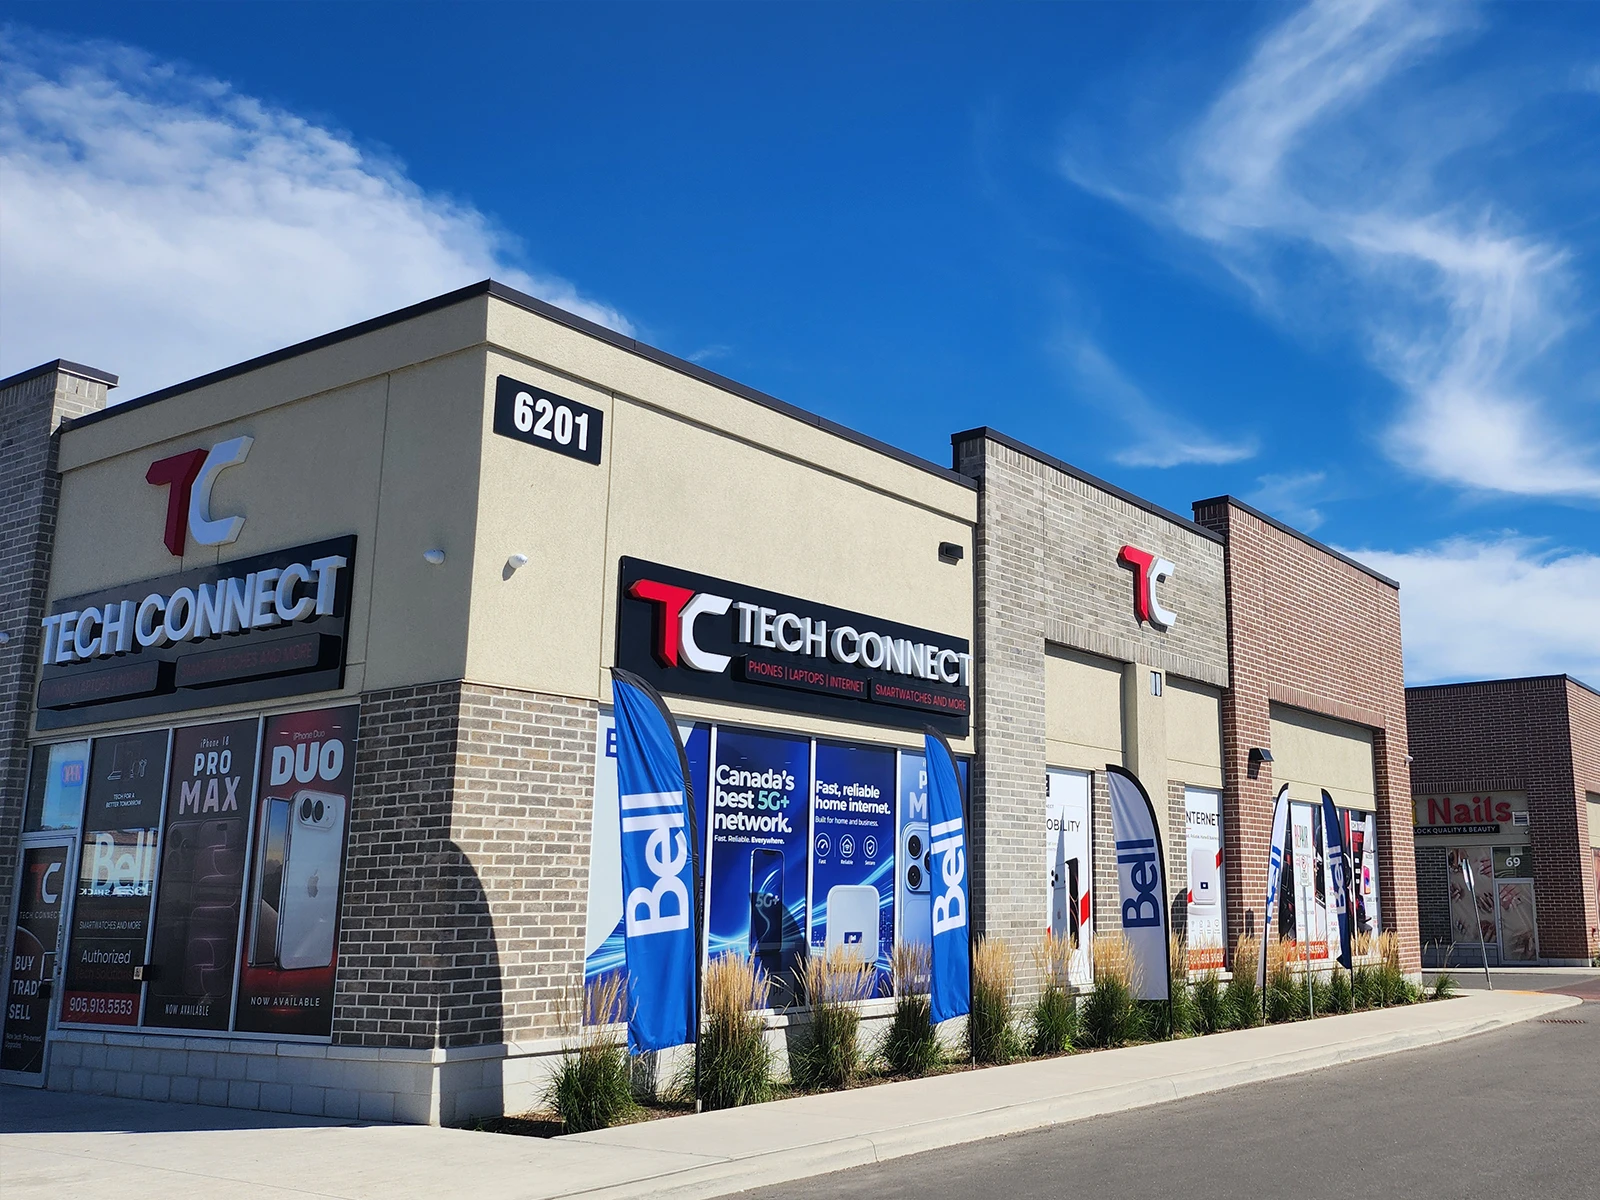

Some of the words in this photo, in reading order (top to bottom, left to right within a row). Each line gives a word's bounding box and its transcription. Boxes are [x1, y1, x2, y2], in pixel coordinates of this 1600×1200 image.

[514, 391, 589, 451] 6201
[41, 600, 137, 664] TECH
[135, 555, 347, 648] CONNECT
[733, 601, 827, 659] TECH
[831, 626, 972, 687] CONNECT
[749, 660, 783, 678] PHONES
[789, 669, 825, 687] LAPTOPS
[830, 676, 864, 693] INTERNET
[875, 683, 932, 706] SMARTWATCHES
[933, 695, 947, 707] AND
[948, 697, 967, 711] MORE
[192, 748, 233, 777] PRO
[270, 738, 345, 786] DUO
[716, 764, 795, 791] Canada's
[816, 779, 841, 798] Fast,
[843, 782, 880, 799] reliable
[179, 776, 242, 815] MAX
[715, 785, 755, 810] best
[757, 790, 789, 811] 5G+
[815, 795, 847, 811] home
[848, 797, 891, 815] internet.
[714, 811, 792, 834] network.
[815, 815, 827, 824] Built
[834, 817, 848, 825] home
[849, 818, 858, 826] and
[1427, 796, 1513, 825] Nails
[714, 834, 727, 843] Fast.
[751, 836, 785, 845] Everywhere.
[1432, 826, 1461, 834] QUALITY
[91, 829, 154, 895] Bell
[621, 790, 690, 938] Bell
[1505, 857, 1521, 867] 69
[930, 816, 967, 937] Bell
[1116, 838, 1161, 928] Bell
[755, 892, 780, 908] 5G+
[20, 911, 34, 920] TECH
[14, 955, 35, 971] BUY
[81, 949, 132, 964] Authorized
[8, 1004, 31, 1020] SELL
[69, 996, 133, 1015] 905.913.5553
[164, 1003, 179, 1015] NOW
[180, 1004, 210, 1016] AVAILABLE
[250, 996, 270, 1006] NOW
[272, 997, 321, 1007] AVAILABLE
